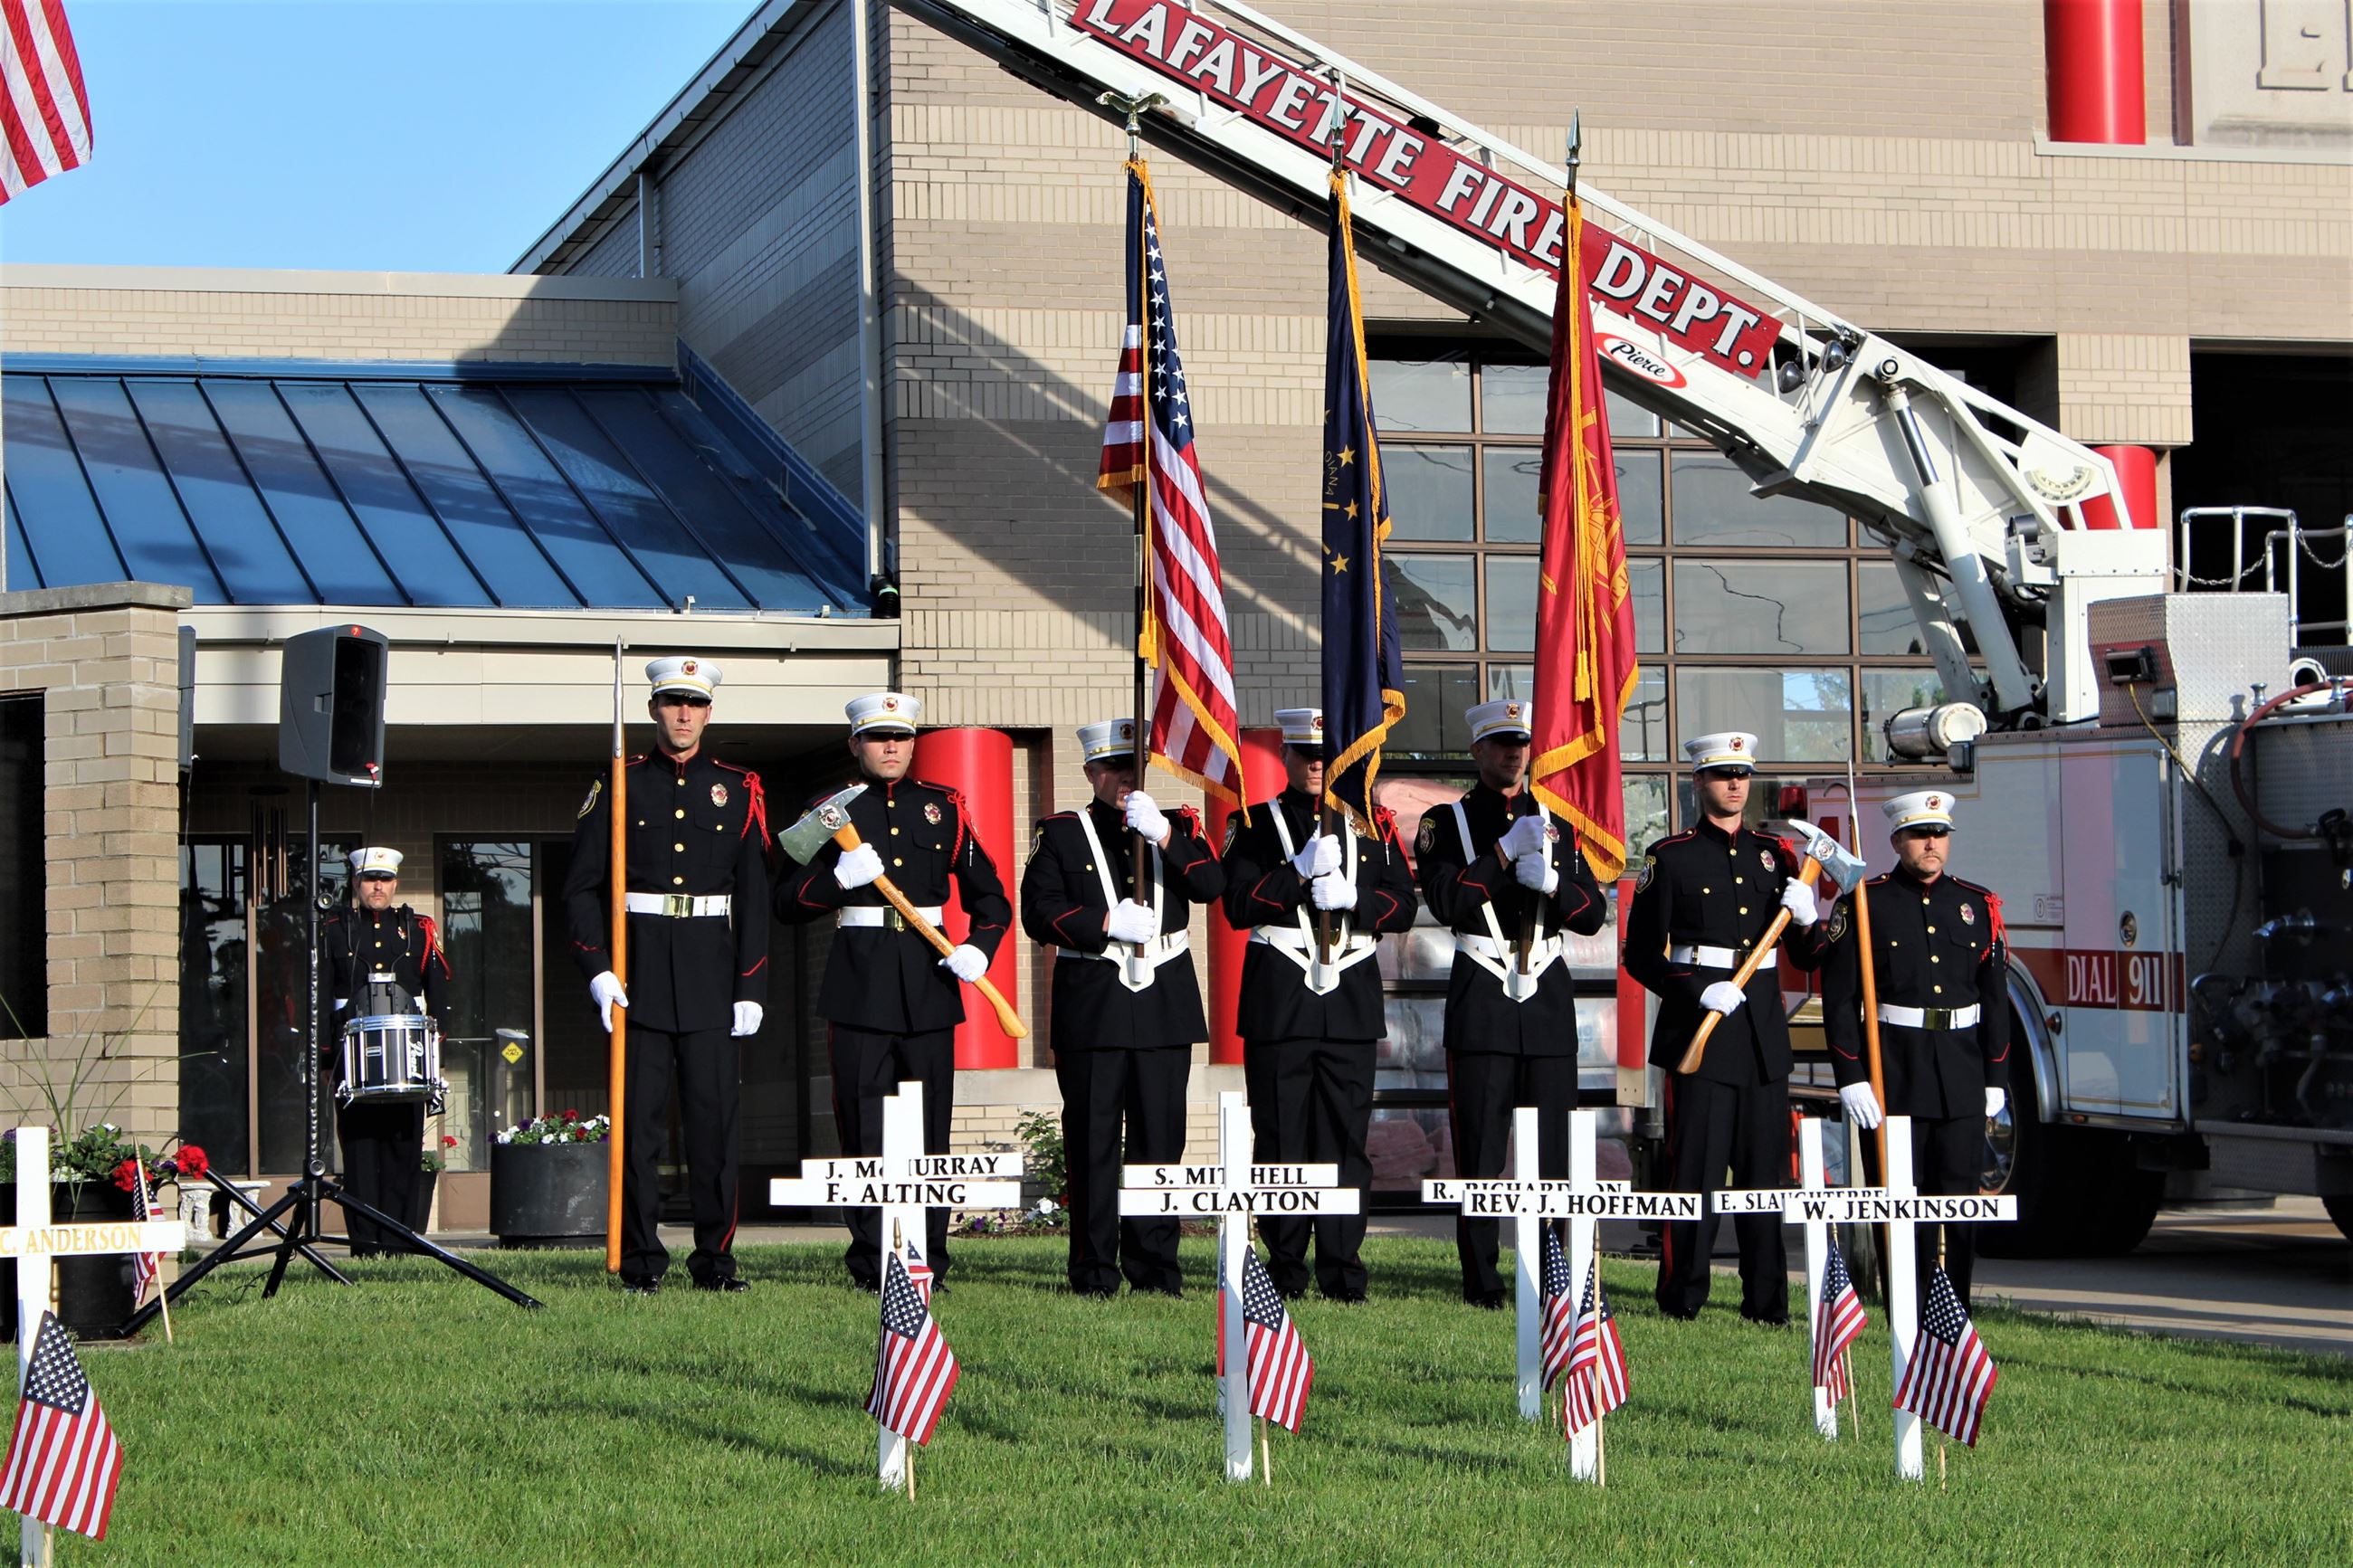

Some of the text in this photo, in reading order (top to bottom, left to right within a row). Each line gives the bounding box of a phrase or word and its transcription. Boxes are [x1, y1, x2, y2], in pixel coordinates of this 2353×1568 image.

[1085, 0, 1760, 368] LAFAYETTE FIRE DEPT.
[1610, 341, 1665, 377] Pierce
[2067, 955, 2161, 1004] DIAL 911
[407, 1039, 424, 1080] Pearl
[825, 1156, 999, 1179] J. MURRAY
[1155, 1167, 1308, 1184] S. MITHELL
[826, 1183, 966, 1203] F. ALTING
[1160, 1191, 1320, 1212] J. CLAYTON
[1433, 1183, 1454, 1199] R.
[1720, 1193, 1737, 1211] E.
[1472, 1193, 1696, 1216] REV. J. HOFFMAN
[1803, 1199, 1999, 1220] W. JENKINSON
[25, 1225, 141, 1253] ANDERSON
